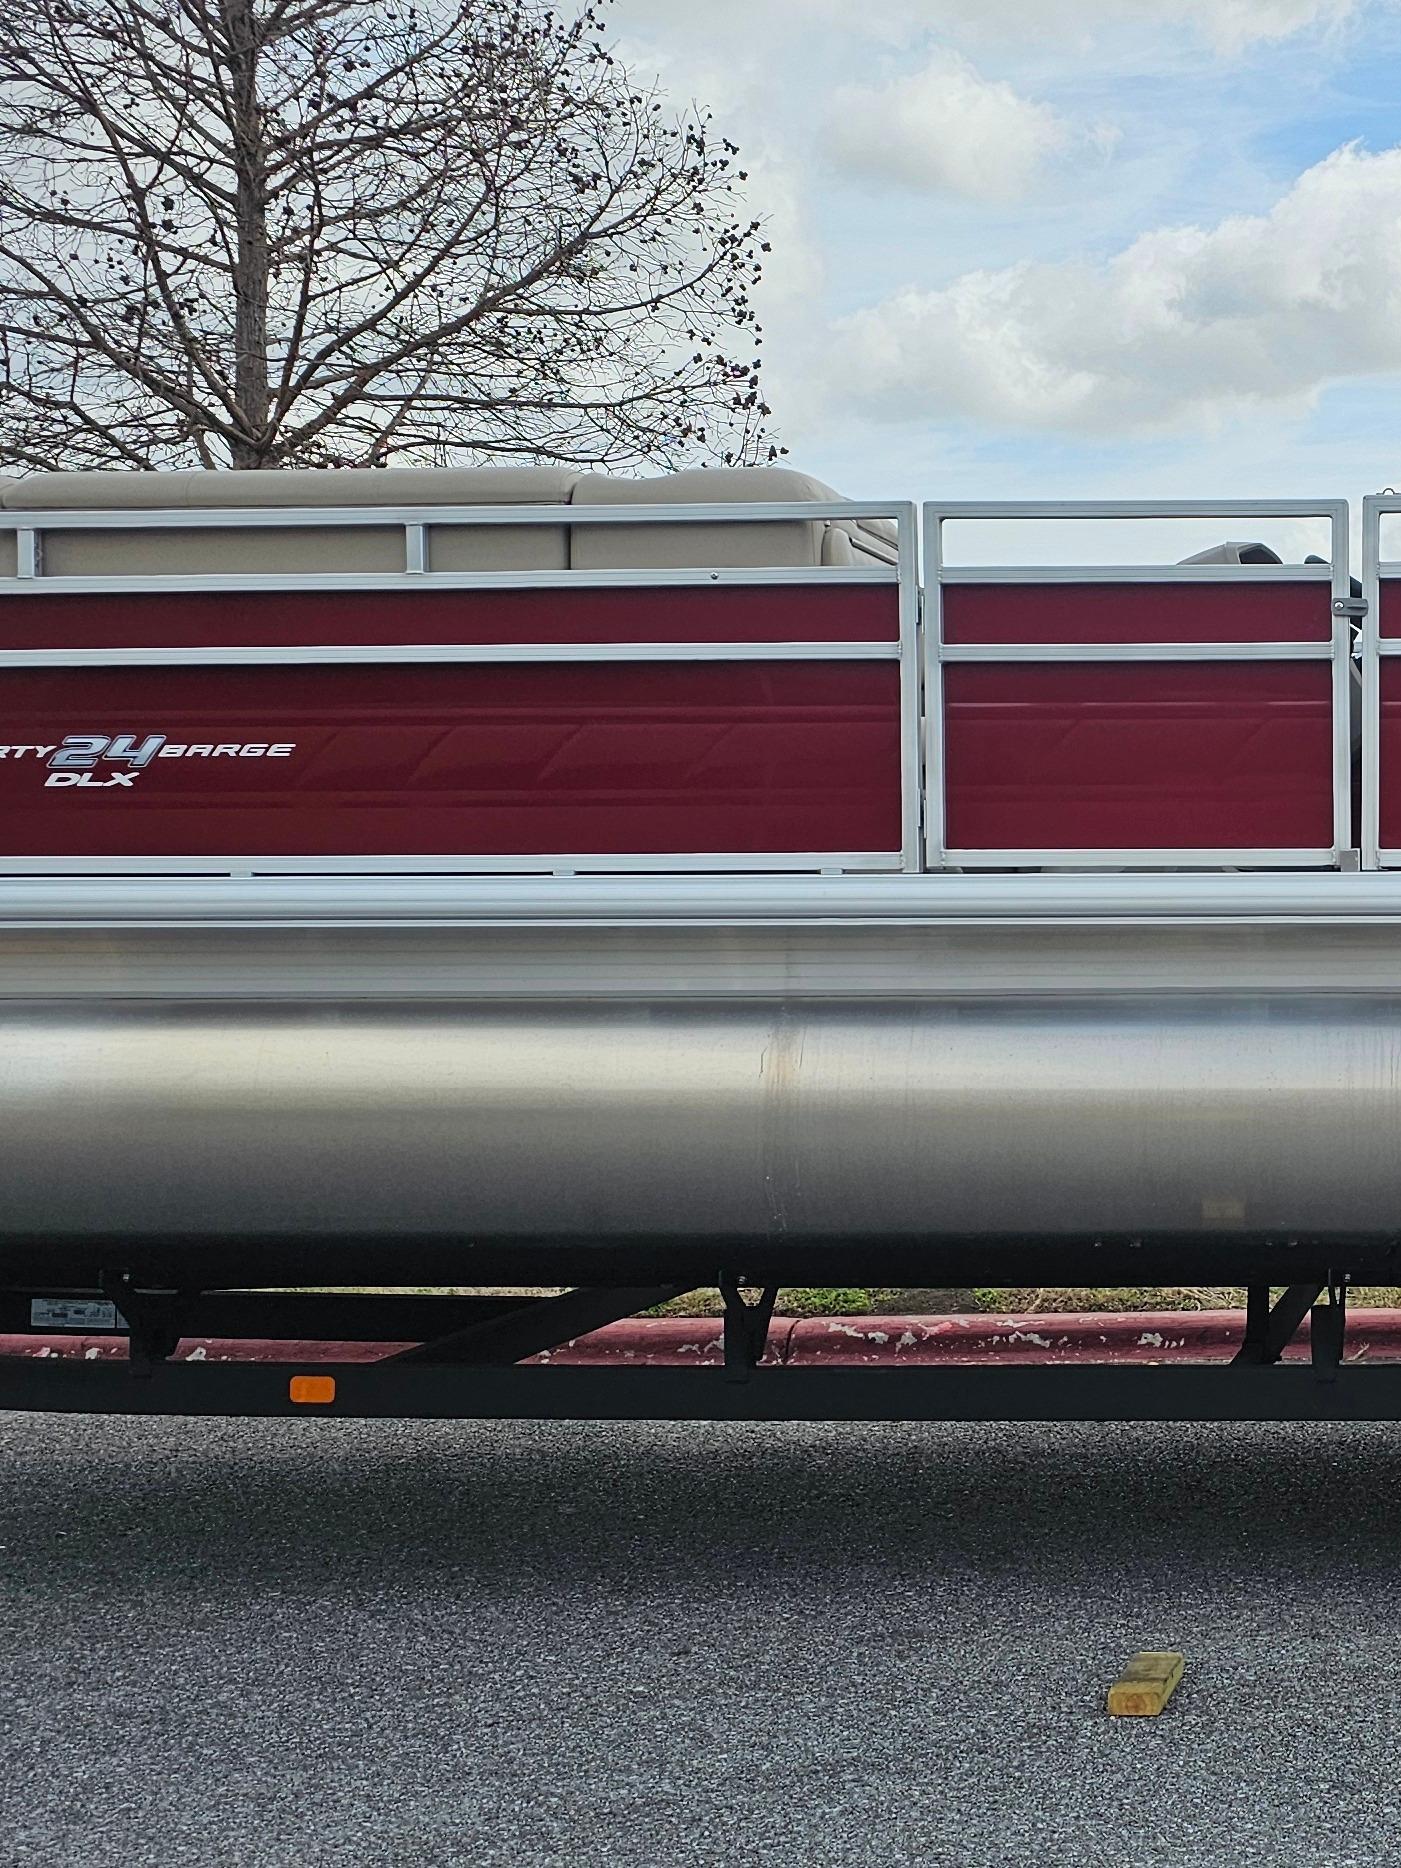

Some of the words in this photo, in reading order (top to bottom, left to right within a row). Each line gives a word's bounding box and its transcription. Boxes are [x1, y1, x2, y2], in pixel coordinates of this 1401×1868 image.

[47, 735, 166, 768] 24
[158, 744, 296, 758] BARGE
[44, 772, 139, 787] DLX
